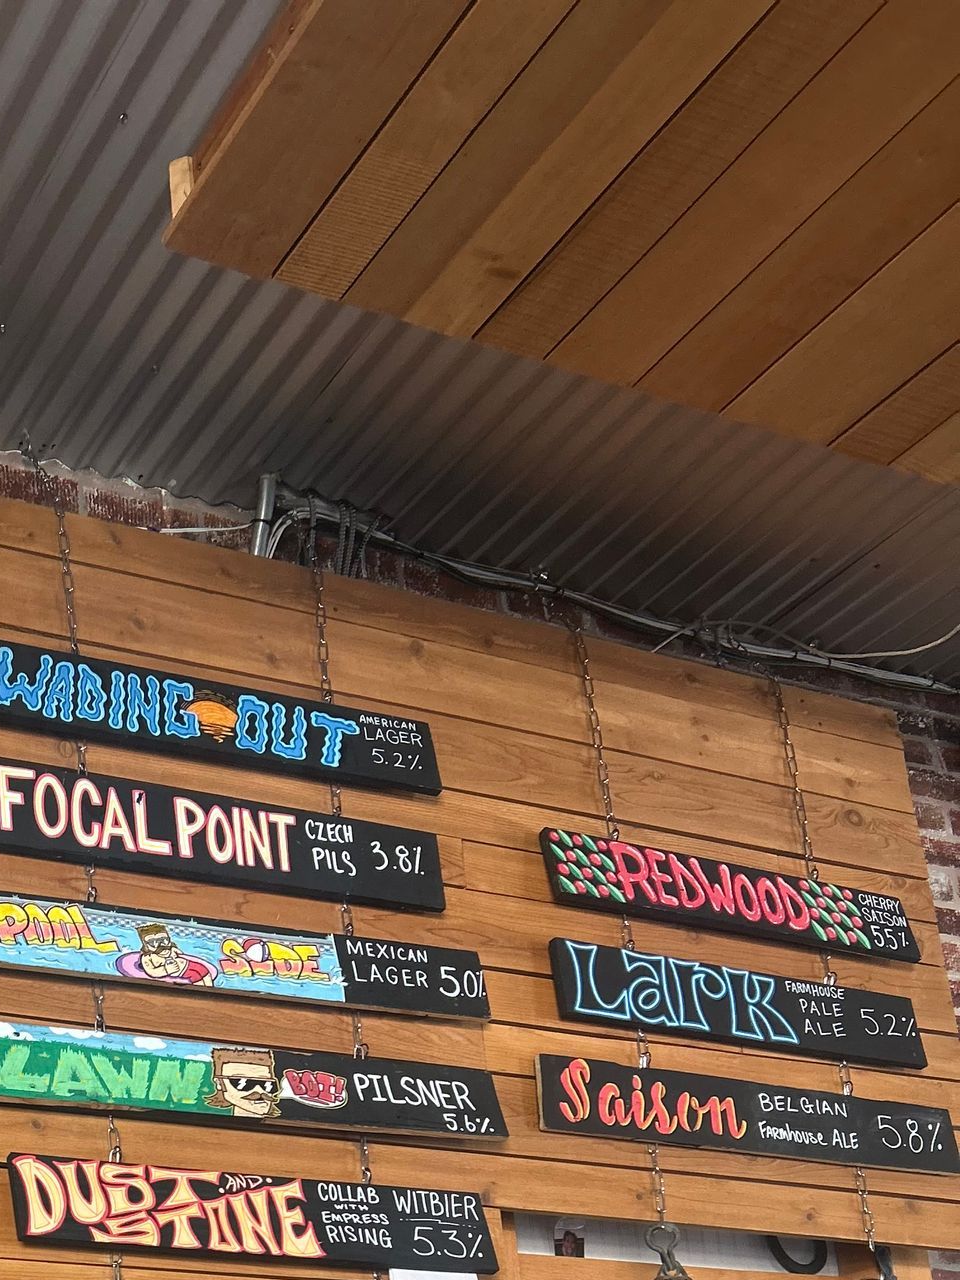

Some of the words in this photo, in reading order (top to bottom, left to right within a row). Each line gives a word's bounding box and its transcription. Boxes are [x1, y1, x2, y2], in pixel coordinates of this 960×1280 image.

[235, 695, 360, 768] OUT
[359, 714, 417, 732] AMERICAN
[363, 727, 423, 748] LAGER
[371, 748, 423, 770] 5.2%
[173, 795, 297, 873] POINT
[305, 818, 354, 844] CZECH
[312, 848, 357, 878] PILS
[369, 840, 425, 876] 3.8%
[608, 841, 812, 931] REDWOOD
[858, 893, 901, 914] CHERRY
[862, 907, 908, 928] SAISON
[346, 939, 428, 964] MEXICAN
[351, 960, 429, 988] LAGER
[439, 966, 487, 998] 5.0%
[784, 980, 845, 1000] FARMHOUSE
[799, 999, 844, 1017] PALE
[804, 1019, 847, 1038] ALE
[860, 1008, 917, 1038] 5.2%
[352, 1073, 476, 1111] PILSNER
[559, 1058, 748, 1139] Saison
[758, 1093, 848, 1117] BELGIAN
[442, 1113, 495, 1134] 5.6%
[878, 1114, 943, 1154] 5.8%
[832, 1129, 859, 1149] ALE
[11, 1153, 226, 1237] DUST
[317, 1183, 380, 1204] COLLAB
[392, 1189, 479, 1221] WITBIER
[91, 1178, 328, 1258] STONE
[321, 1211, 390, 1226] EMPRESS
[334, 1203, 369, 1212] WITH
[325, 1225, 393, 1249] RISING
[412, 1226, 483, 1259] 5.3%
